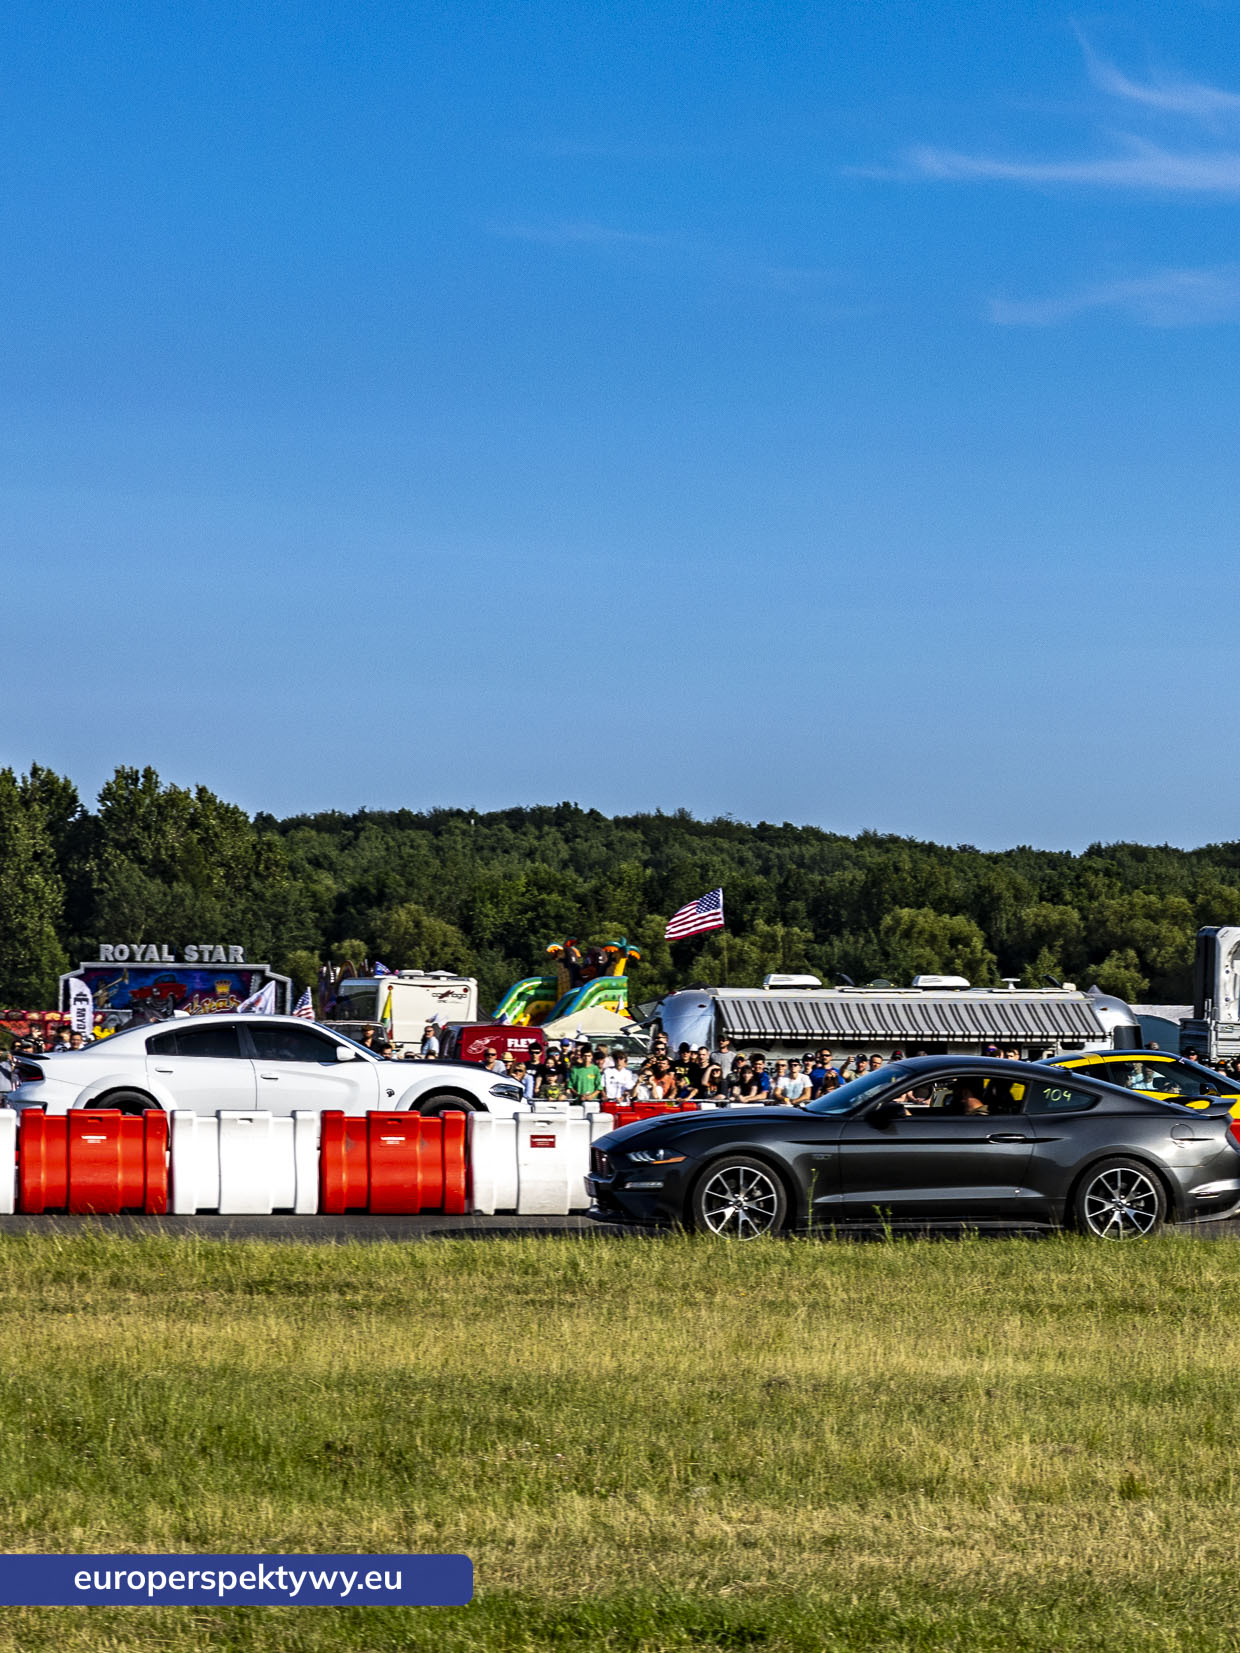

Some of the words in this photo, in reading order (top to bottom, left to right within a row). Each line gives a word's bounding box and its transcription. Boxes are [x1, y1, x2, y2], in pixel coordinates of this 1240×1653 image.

[100, 944, 175, 961] ROYAL
[184, 945, 244, 963] STAR
[1043, 1088, 1072, 1101] 104
